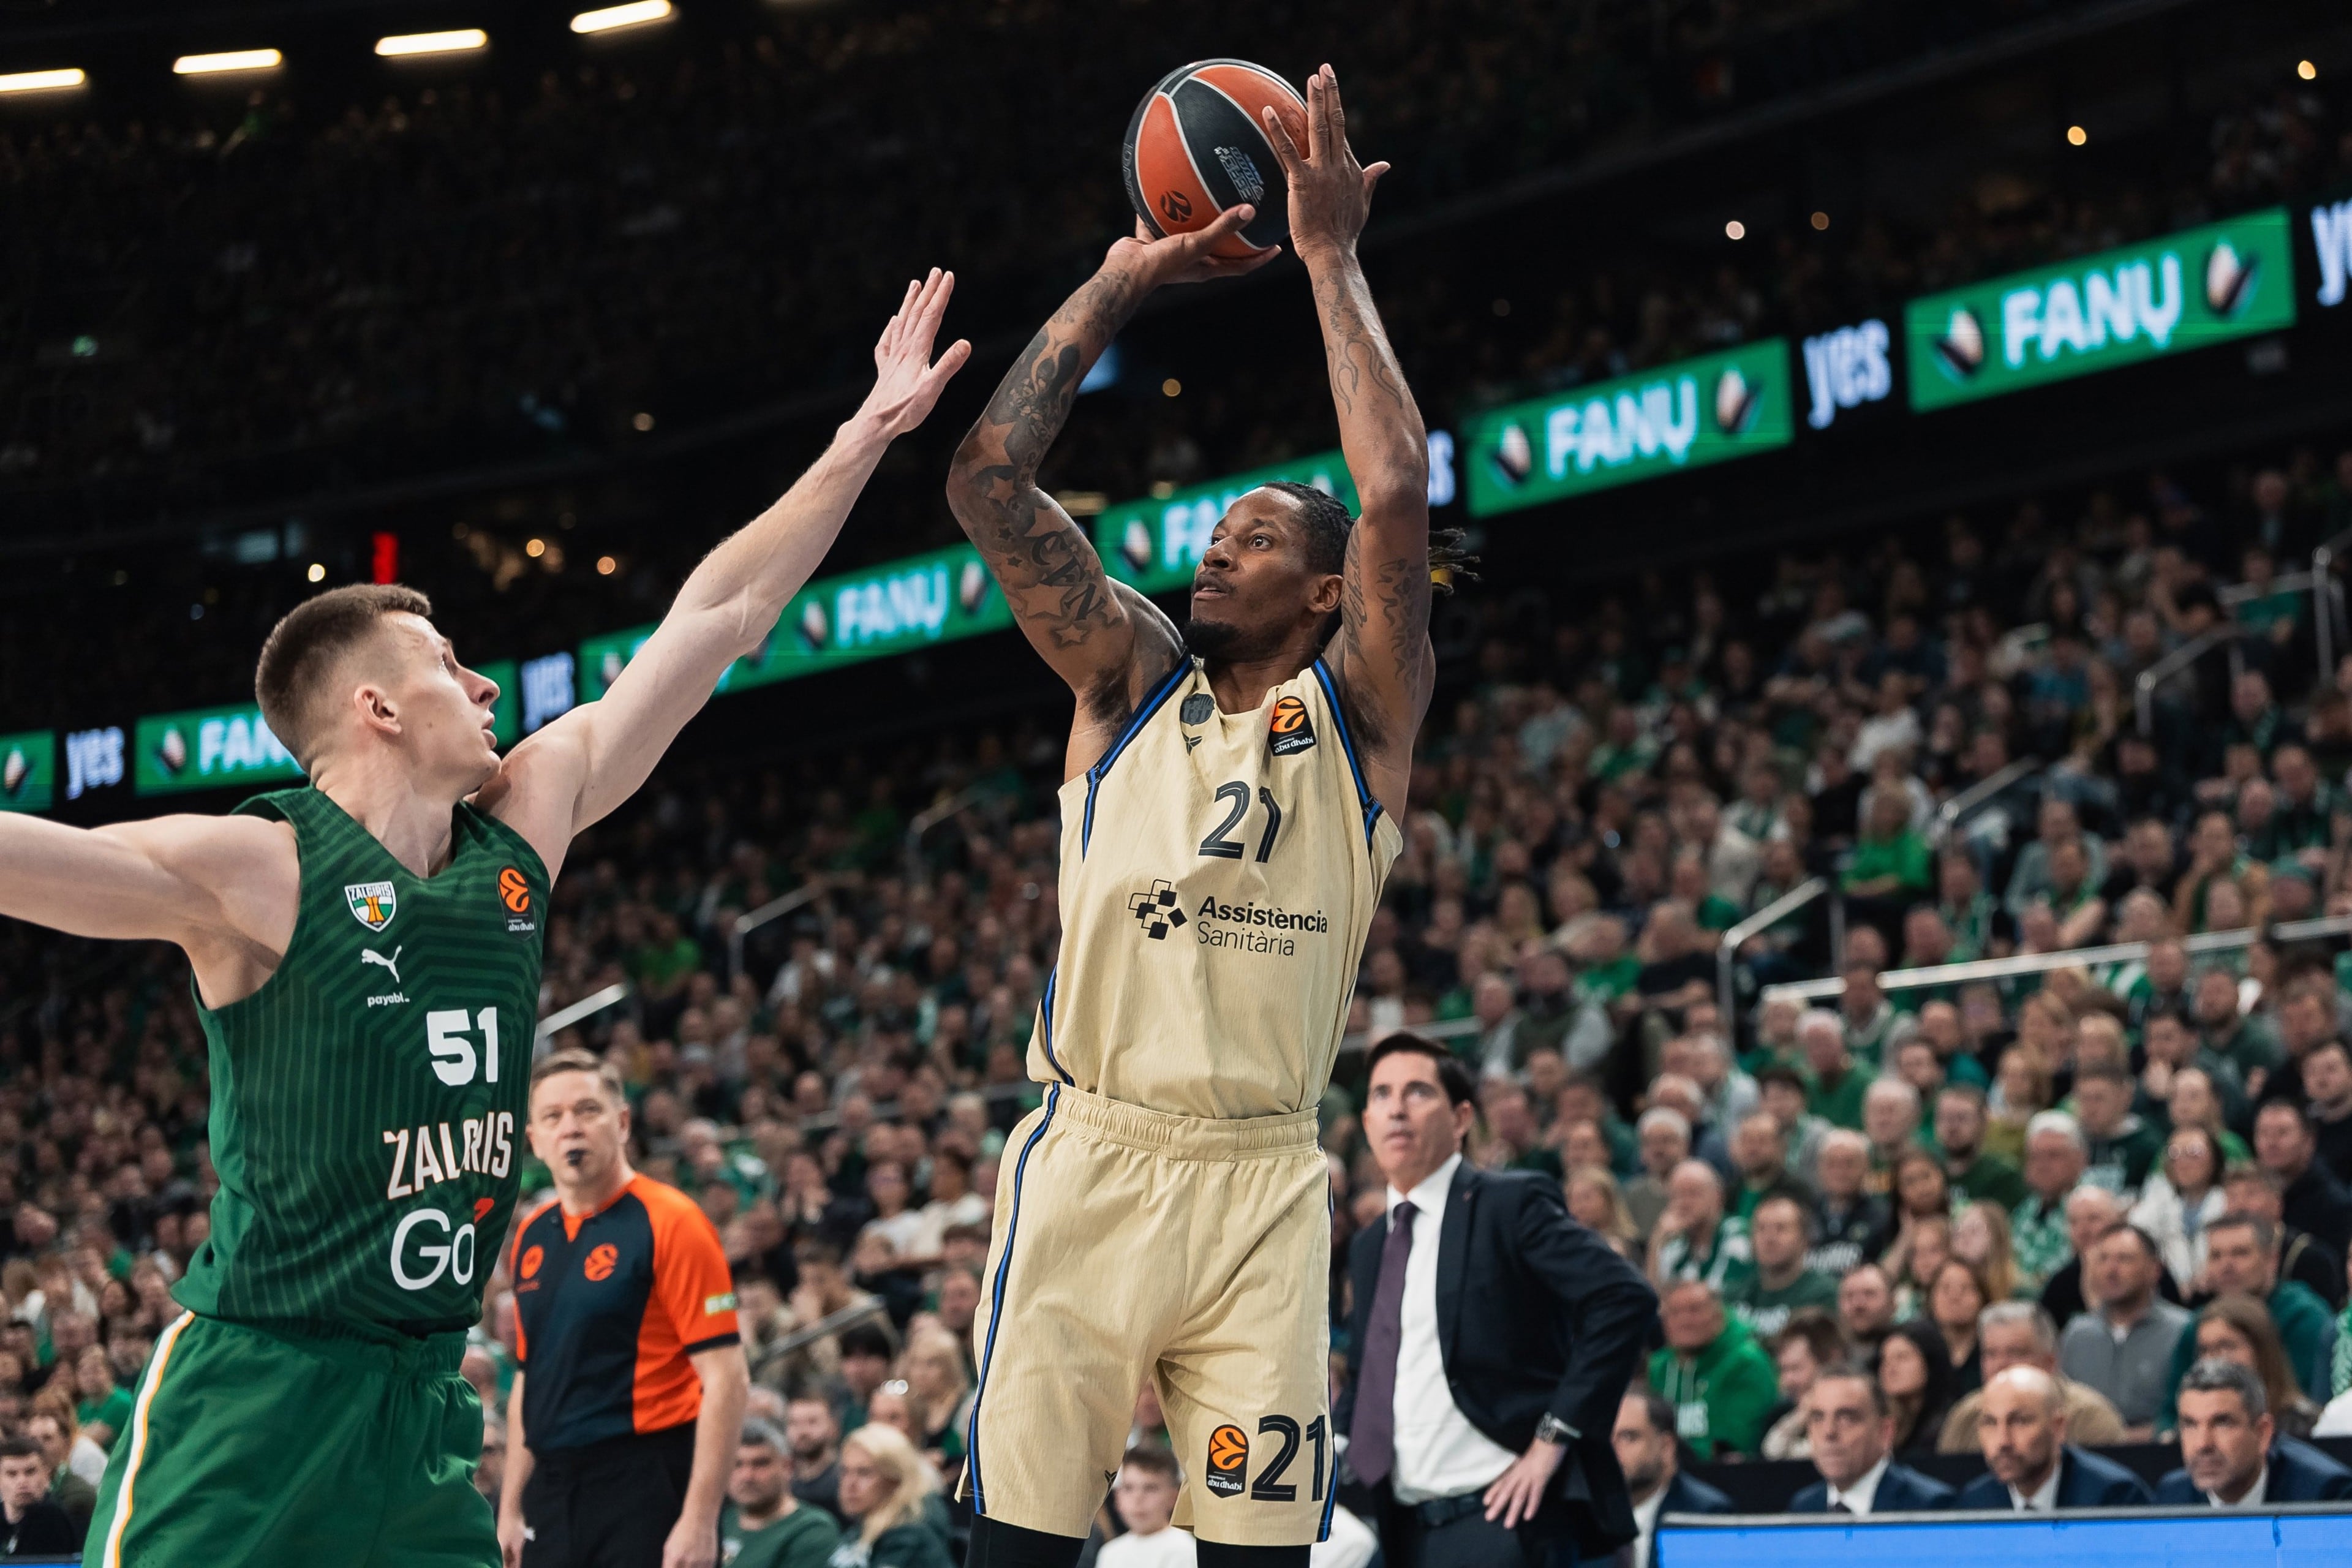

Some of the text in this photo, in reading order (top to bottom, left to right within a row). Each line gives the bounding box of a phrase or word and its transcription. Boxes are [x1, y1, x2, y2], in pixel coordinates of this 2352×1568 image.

[199, 712, 295, 775] FAN
[1275, 736, 1314, 753] abu dhabi
[1198, 781, 1281, 864] 21
[1198, 896, 1327, 933] Assistència
[1198, 921, 1294, 956] Sanitària
[427, 1007, 498, 1086] 51
[1251, 1414, 1325, 1502] 21
[1220, 1481, 1242, 1491] dhabi
